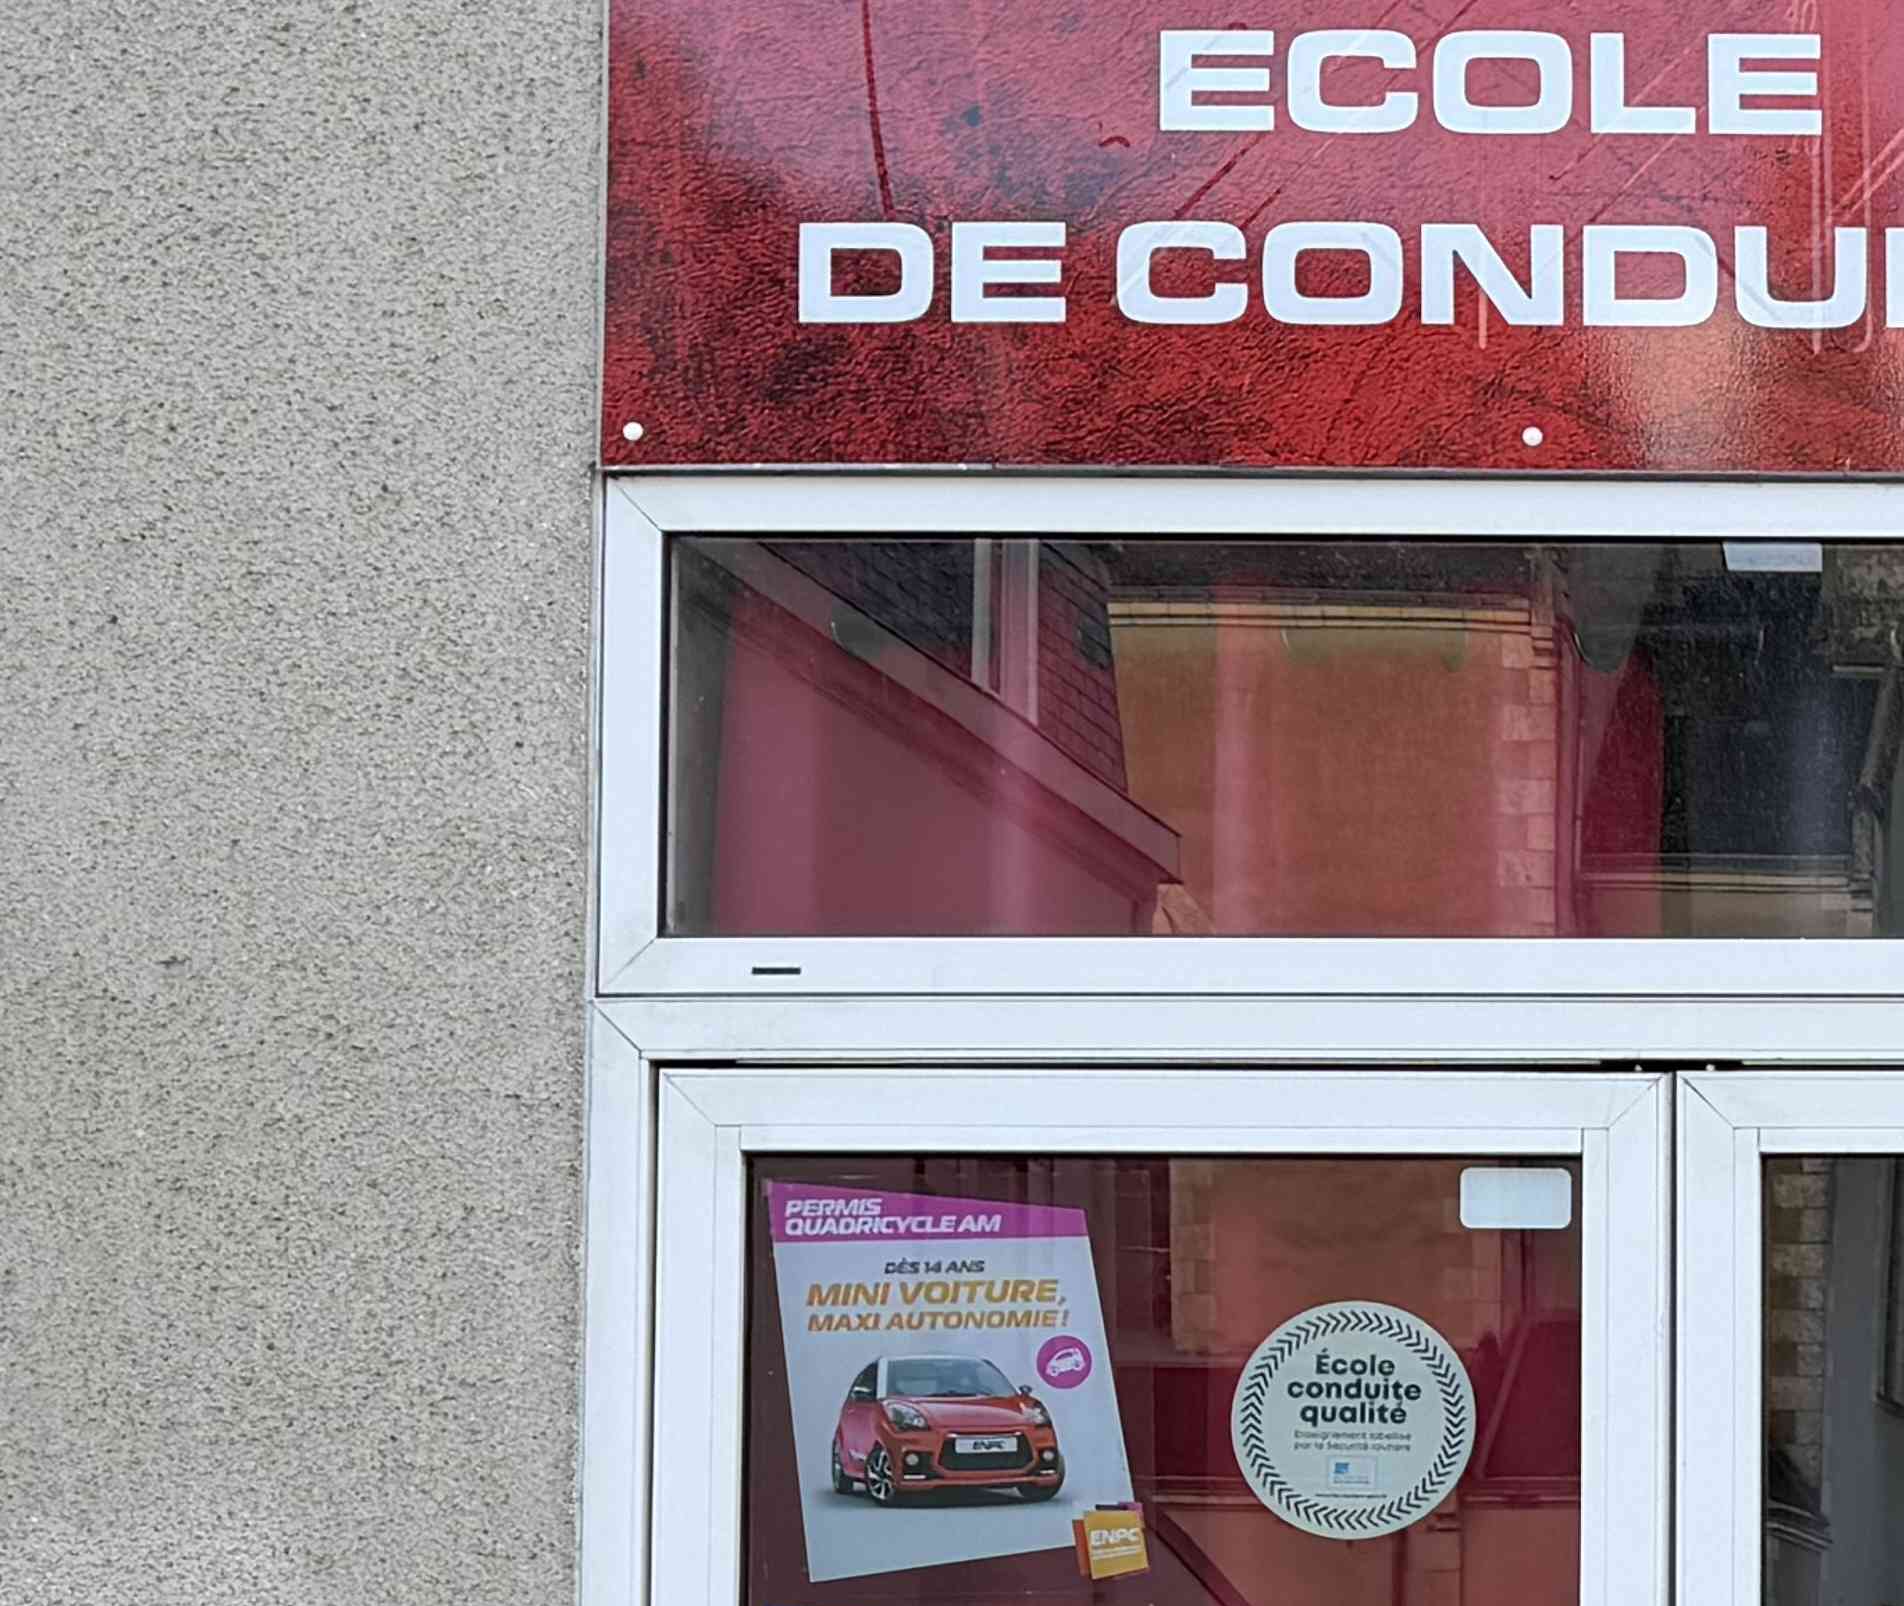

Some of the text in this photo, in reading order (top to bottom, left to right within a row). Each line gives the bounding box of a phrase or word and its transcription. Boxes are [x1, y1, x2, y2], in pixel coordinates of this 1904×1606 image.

[1158, 28, 1823, 136] ECOLE
[797, 220, 1064, 325] DE
[785, 1198, 882, 1216] PERMIS
[785, 1214, 1002, 1236] QUADRICYCLE AM
[946, 1260, 985, 1274] ANS
[806, 1279, 1066, 1307] MINI VOITURE,
[807, 1309, 1060, 1332] MAXI AUTONOMIE
[1316, 1348, 1395, 1376] École
[1287, 1378, 1421, 1401] conduite
[1300, 1402, 1407, 1427] qualité
[1090, 1528, 1139, 1545] ENPC
